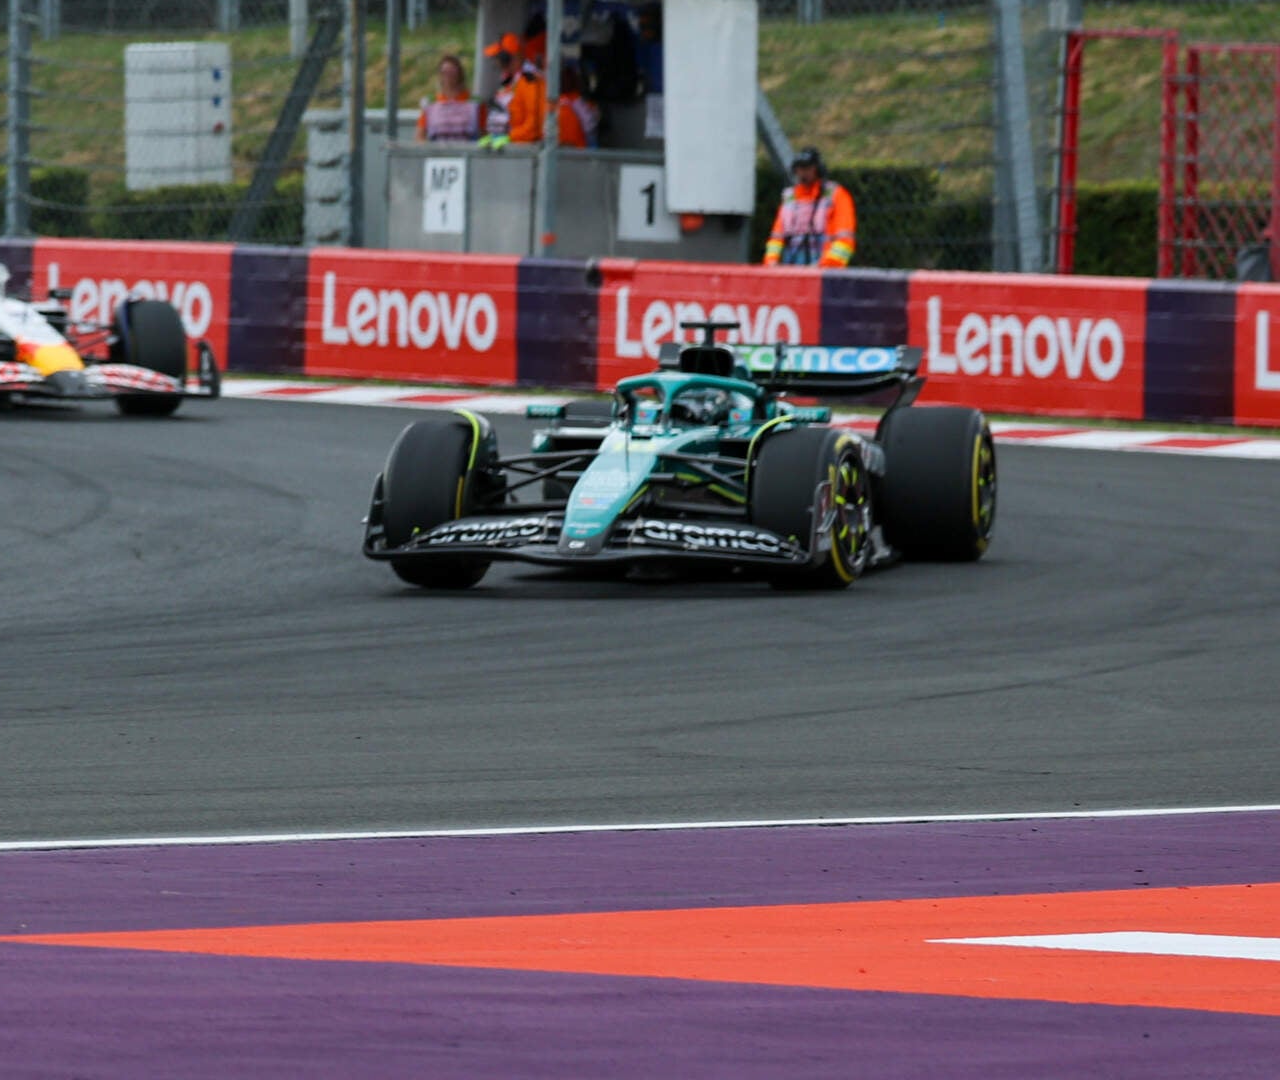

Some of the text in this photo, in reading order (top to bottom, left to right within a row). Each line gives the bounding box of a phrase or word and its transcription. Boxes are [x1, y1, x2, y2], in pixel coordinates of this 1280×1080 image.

[431, 166, 459, 191] MP
[640, 181, 657, 227] 1
[322, 270, 499, 352] Lenovo
[926, 295, 1125, 382] Lenovo
[736, 346, 889, 371] ramco
[644, 520, 780, 552] aramco
